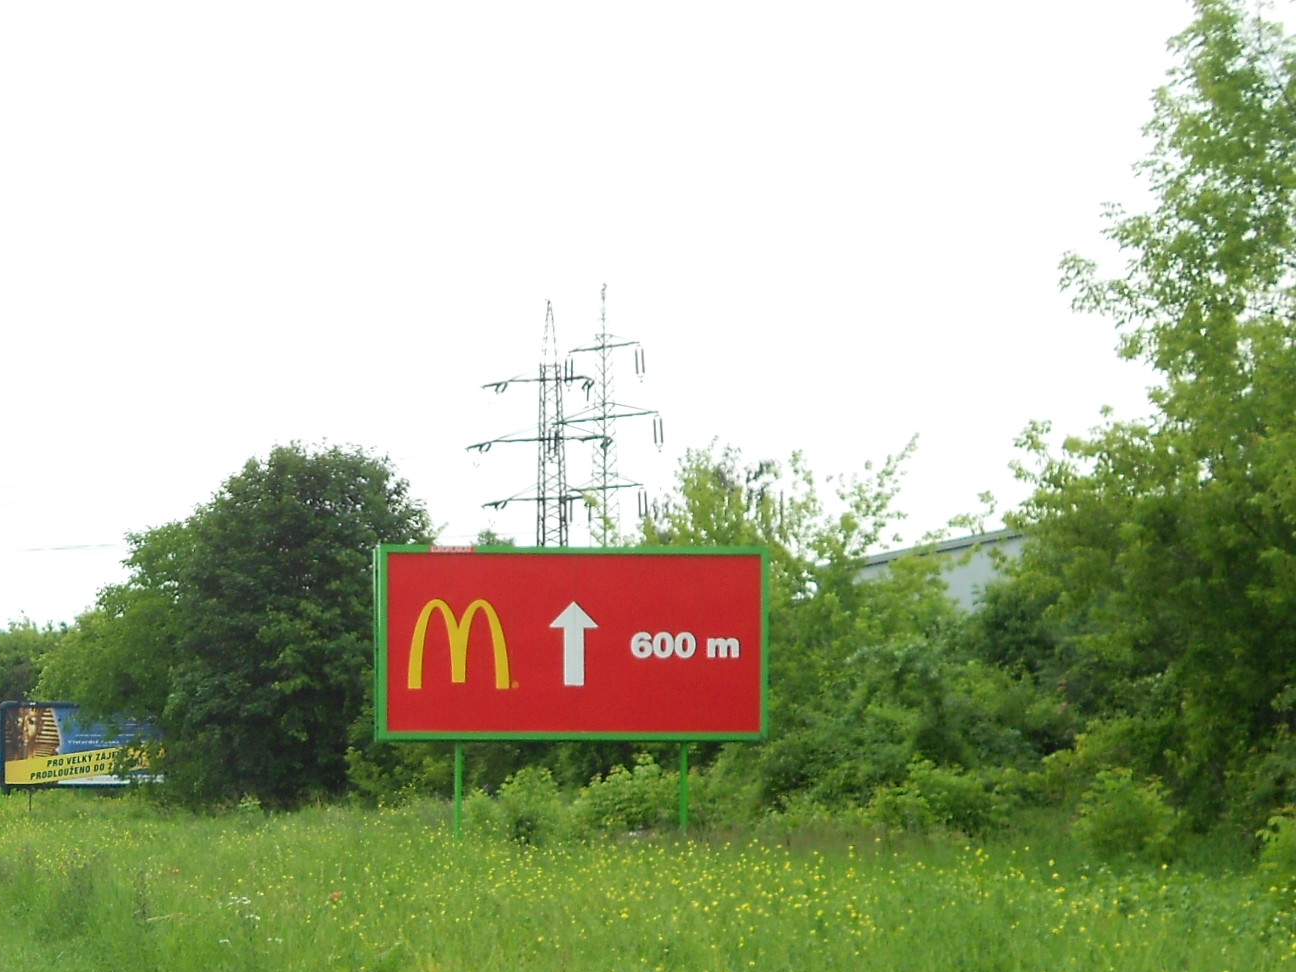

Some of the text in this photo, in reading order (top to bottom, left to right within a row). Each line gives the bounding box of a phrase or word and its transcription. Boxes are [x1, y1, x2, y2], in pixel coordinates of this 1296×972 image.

[630, 631, 740, 658] 600 m
[46, 758, 64, 768] PRO
[66, 752, 93, 766] VELKÝ
[30, 764, 91, 781] PRODLOUŽENO
[94, 763, 105, 772] DO
